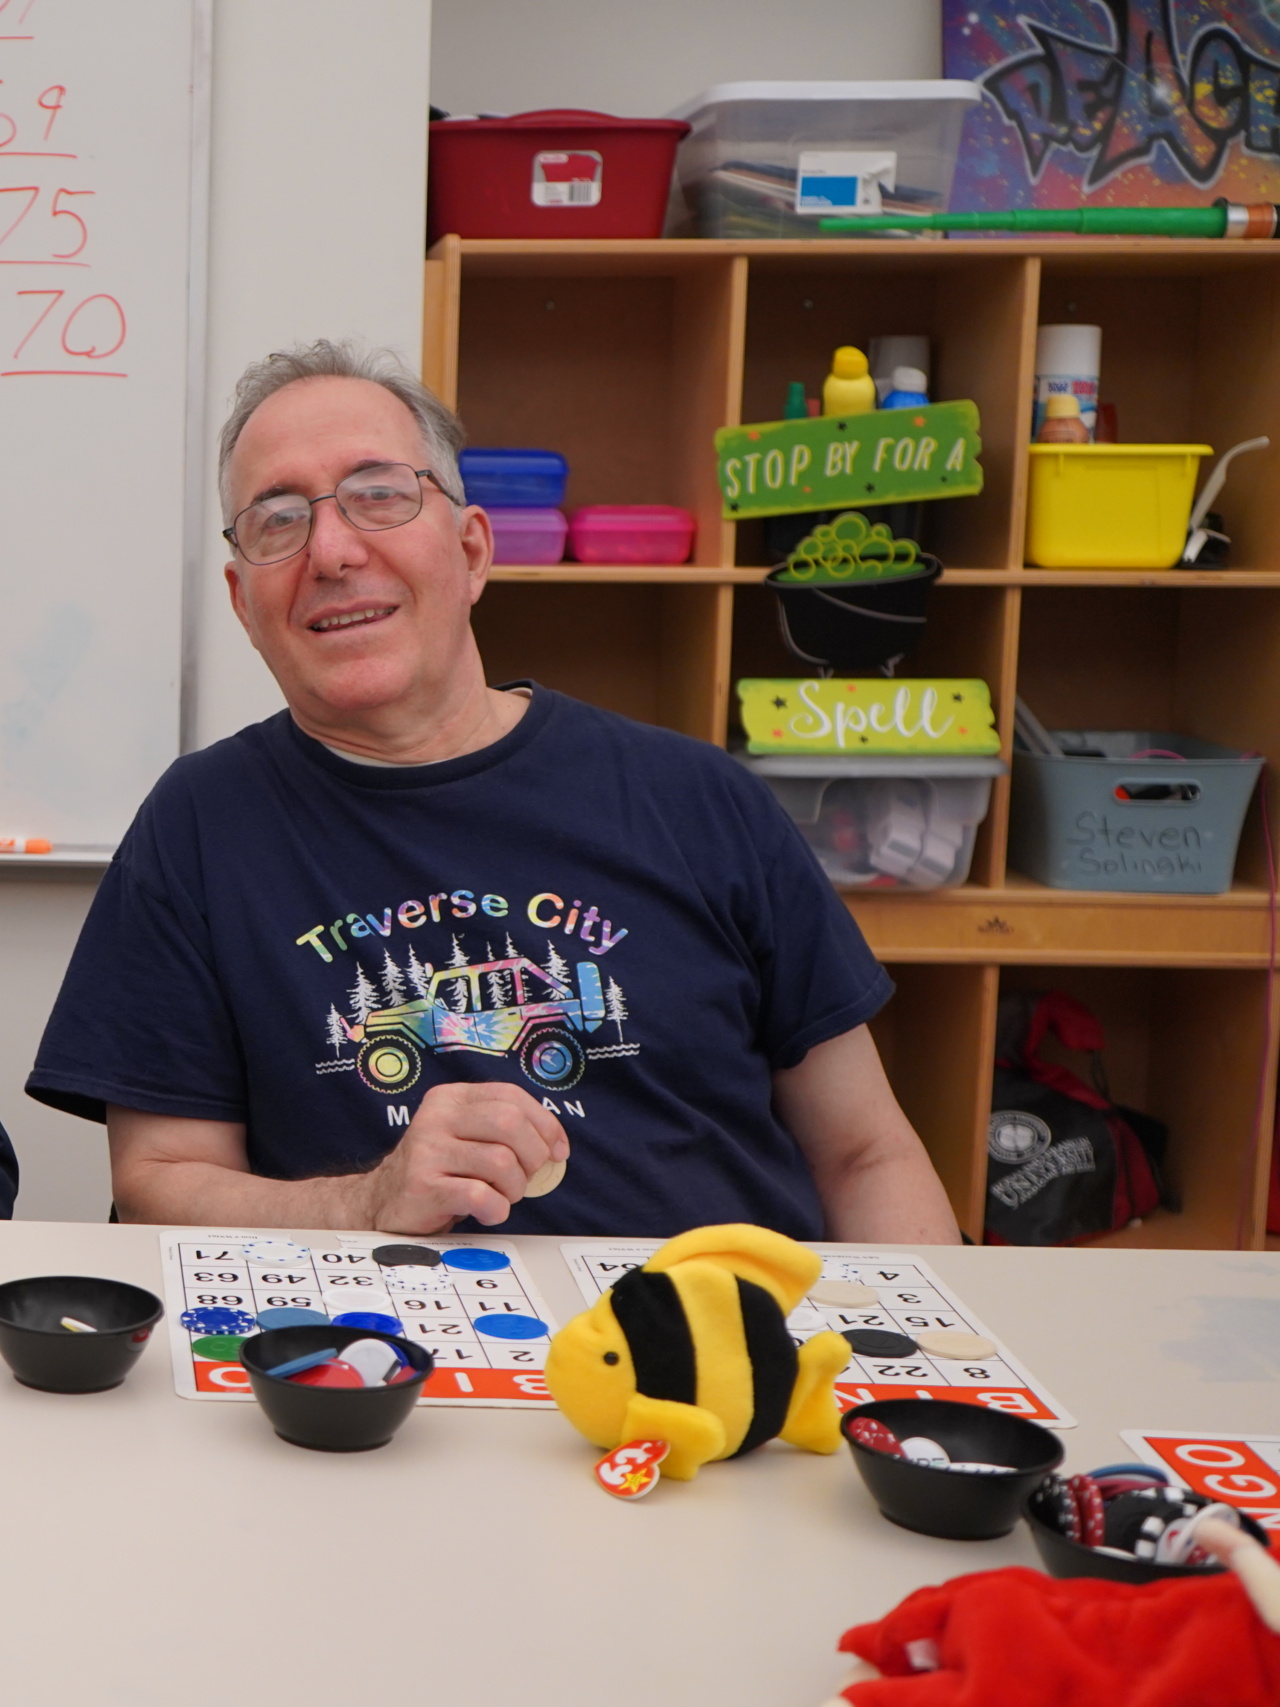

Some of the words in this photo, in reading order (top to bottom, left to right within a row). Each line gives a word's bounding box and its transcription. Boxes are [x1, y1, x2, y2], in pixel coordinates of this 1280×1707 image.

[16, 289, 127, 360] 70
[725, 444, 812, 499] STOP
[824, 439, 861, 478] BY
[873, 436, 939, 473] FOR
[945, 437, 966, 472] A
[788, 679, 956, 750] Spell
[1066, 809, 1202, 851] Steven
[296, 889, 509, 963] Traverse
[527, 892, 629, 955] City
[193, 1250, 235, 1260] 71
[321, 1253, 367, 1263] 40
[193, 1272, 240, 1283] 63
[261, 1274, 308, 1284] 49
[326, 1275, 374, 1286] 32
[877, 1270, 900, 1281] 4
[196, 1295, 244, 1306] 68
[266, 1297, 312, 1308] 59
[896, 1293, 922, 1304] 3
[403, 1299, 452, 1311] 16
[477, 1301, 521, 1312] 11
[838, 1314, 886, 1327] 21
[905, 1316, 955, 1329] 15
[418, 1324, 463, 1335] 21
[508, 1350, 535, 1362] 2
[873, 1365, 928, 1378] 22
[963, 1367, 991, 1379] 8
